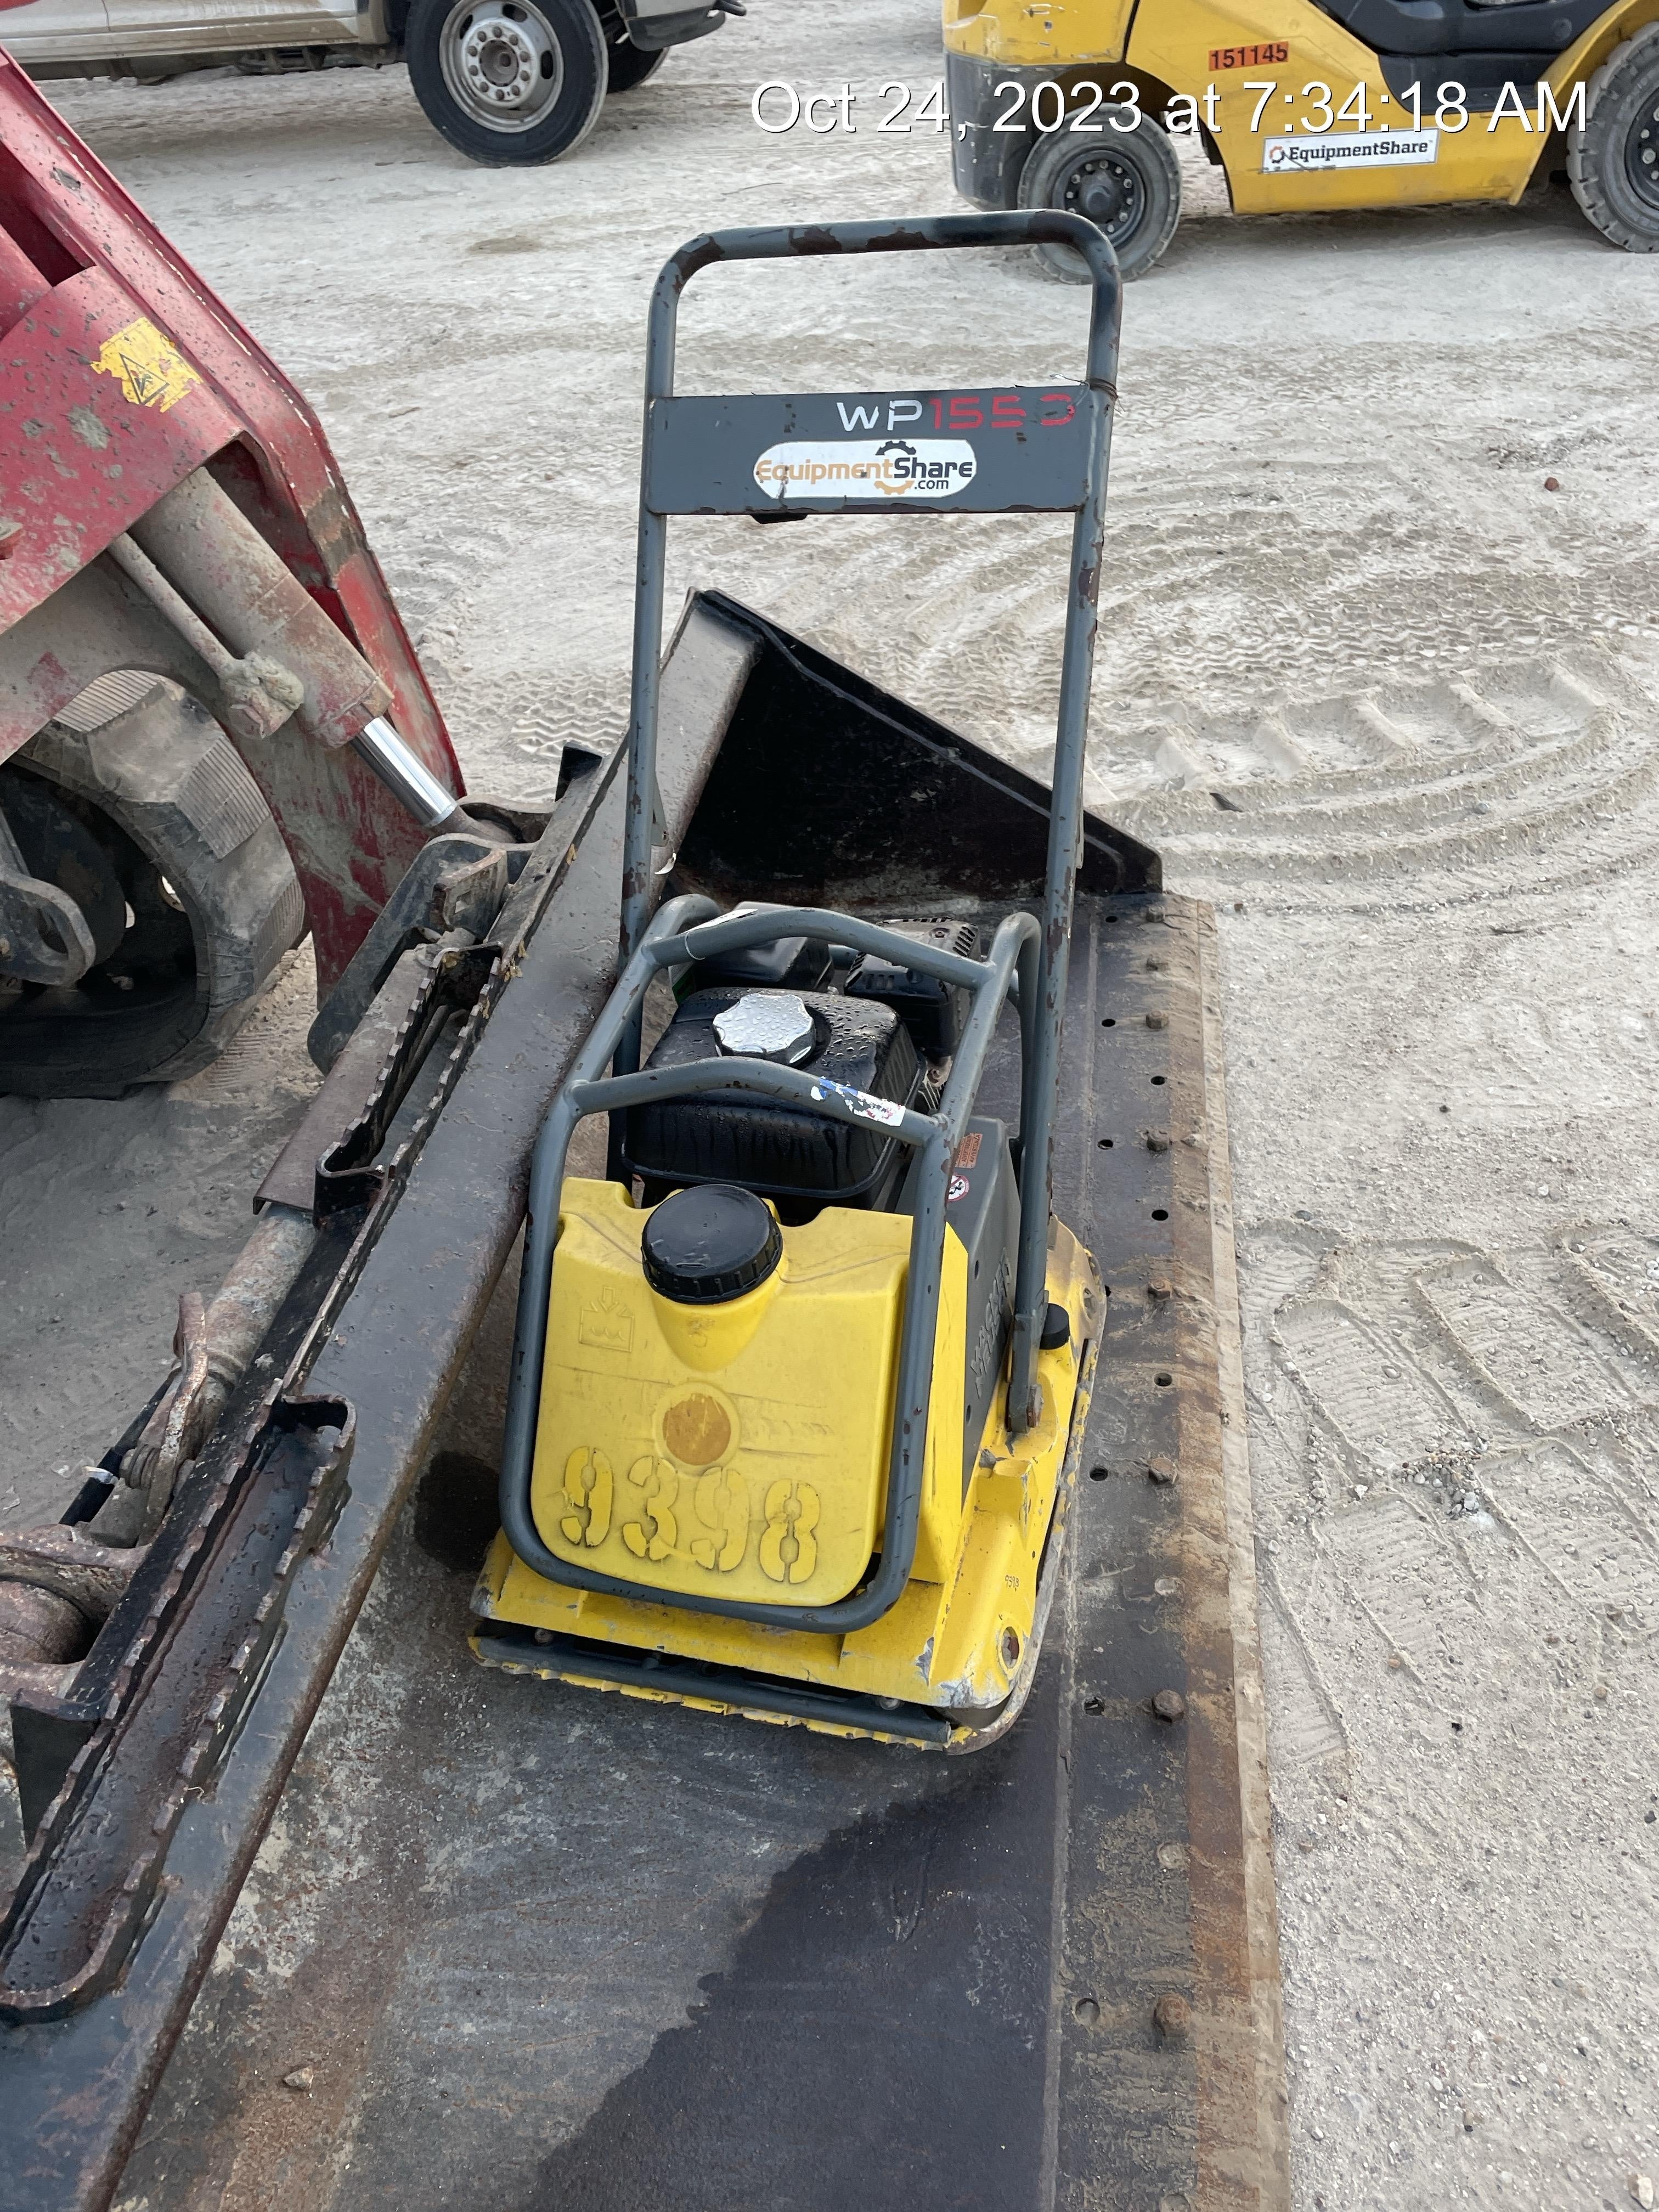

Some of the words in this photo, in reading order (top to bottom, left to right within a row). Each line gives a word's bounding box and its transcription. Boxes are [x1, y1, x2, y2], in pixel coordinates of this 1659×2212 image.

[1211, 44, 1288, 69] 151145
[1289, 140, 1428, 162] EquipmentShare
[757, 457, 973, 484] EquipmentShare
[914, 480, 949, 489] .com
[561, 1446, 820, 1584] 9398
